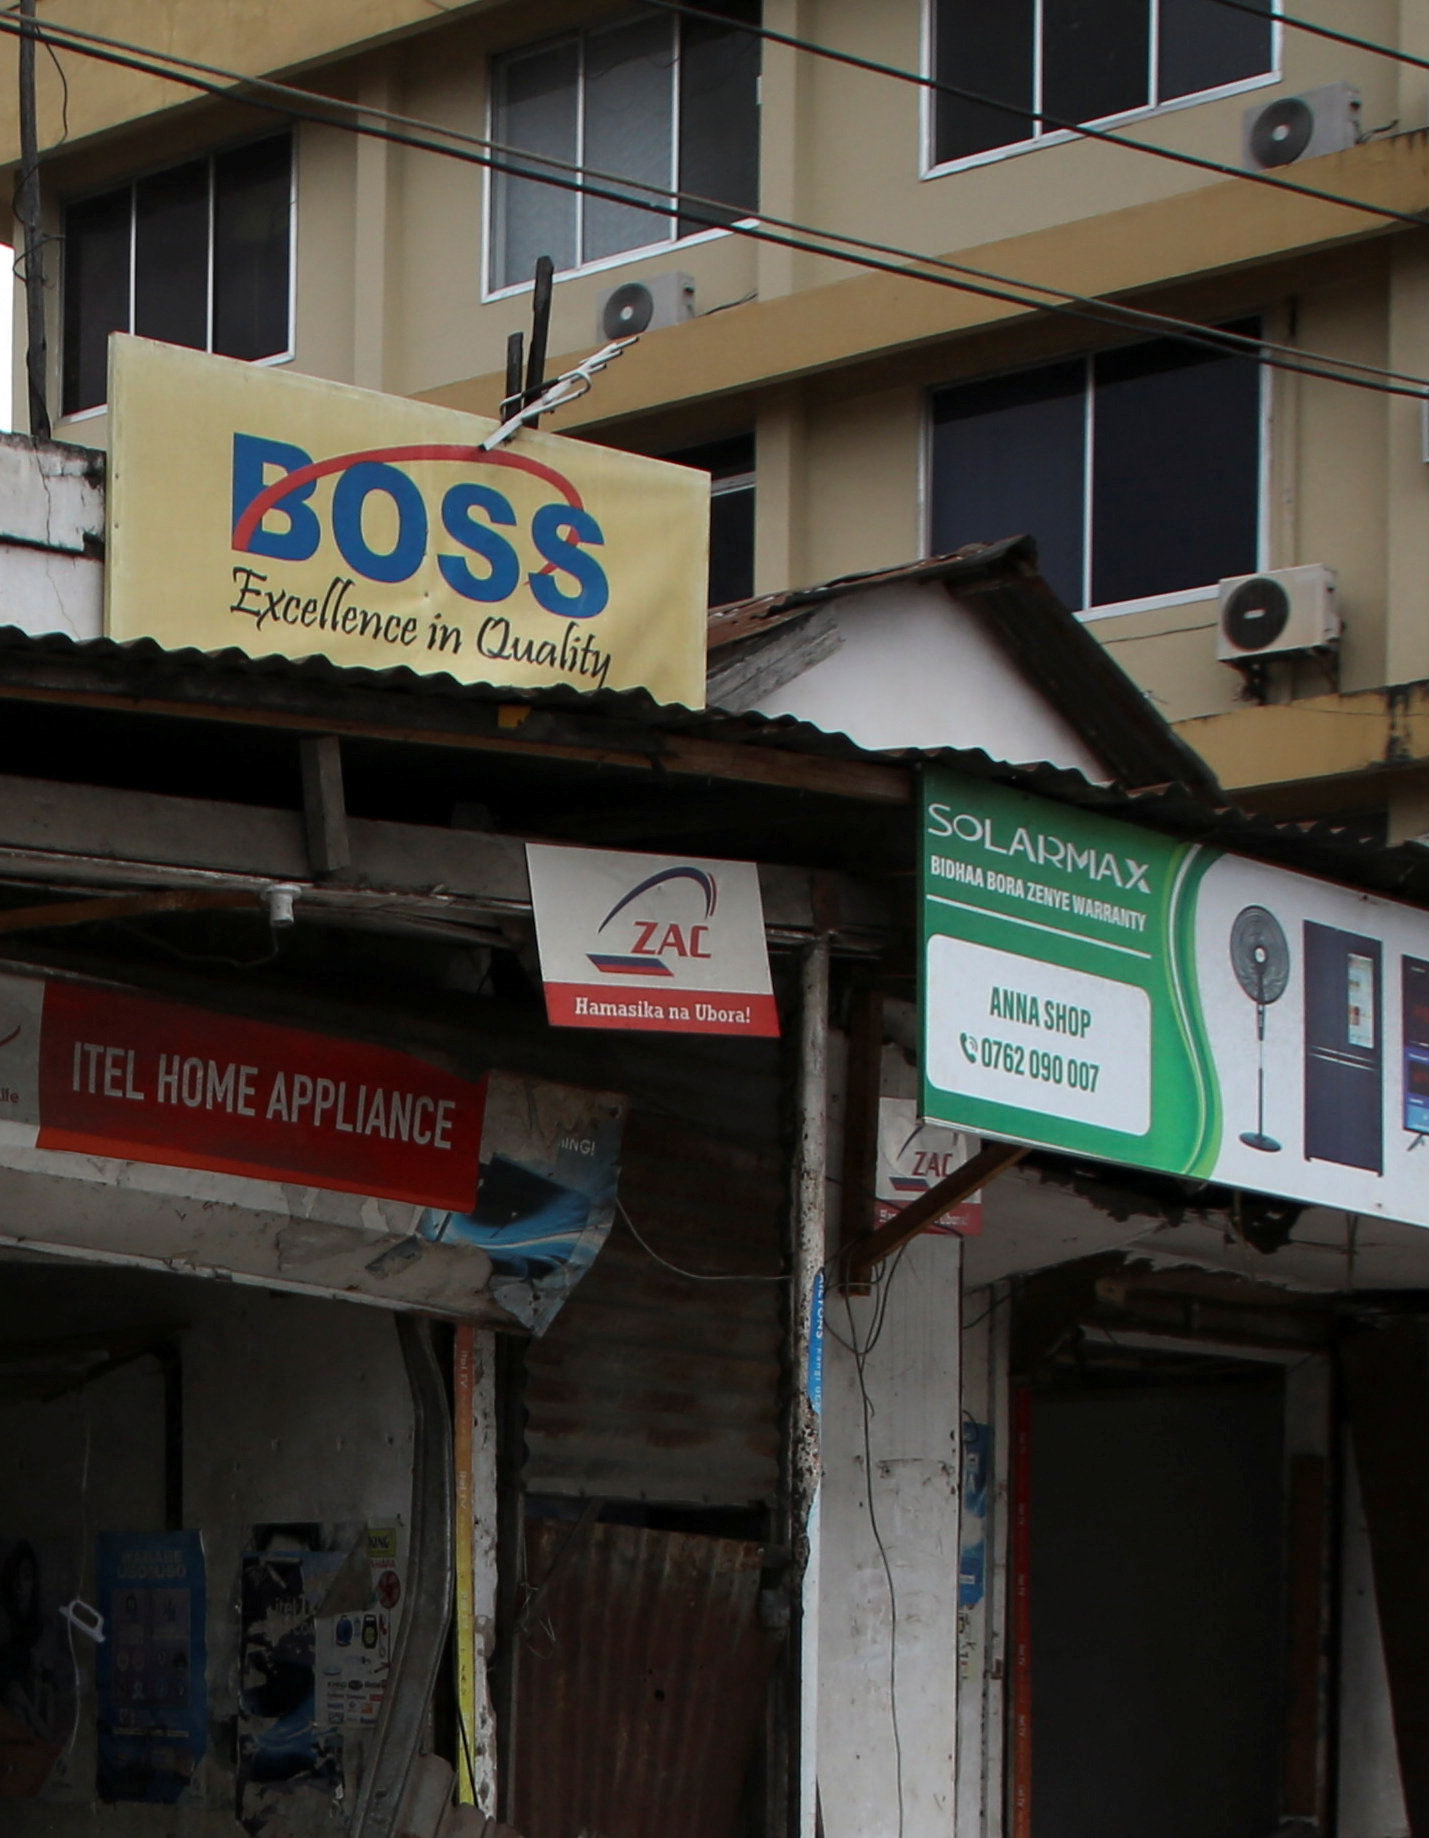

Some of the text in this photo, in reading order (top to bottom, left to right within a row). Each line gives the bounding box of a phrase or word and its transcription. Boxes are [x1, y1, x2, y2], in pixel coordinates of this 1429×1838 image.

[231, 431, 610, 620] BOSS
[230, 566, 612, 688] Excellence in Quality
[927, 803, 1151, 895] SOLARMAX
[930, 855, 1147, 933] BIDHAA BORA ZENYE WARRANTY
[630, 921, 712, 959] ZAC
[574, 996, 751, 1024] Hamasika na Ubora!
[990, 985, 1091, 1039] ANNA SHOP
[72, 1041, 456, 1150] ITEL HOME APPLIANCE
[981, 1037, 1101, 1094] 0762 090 007
